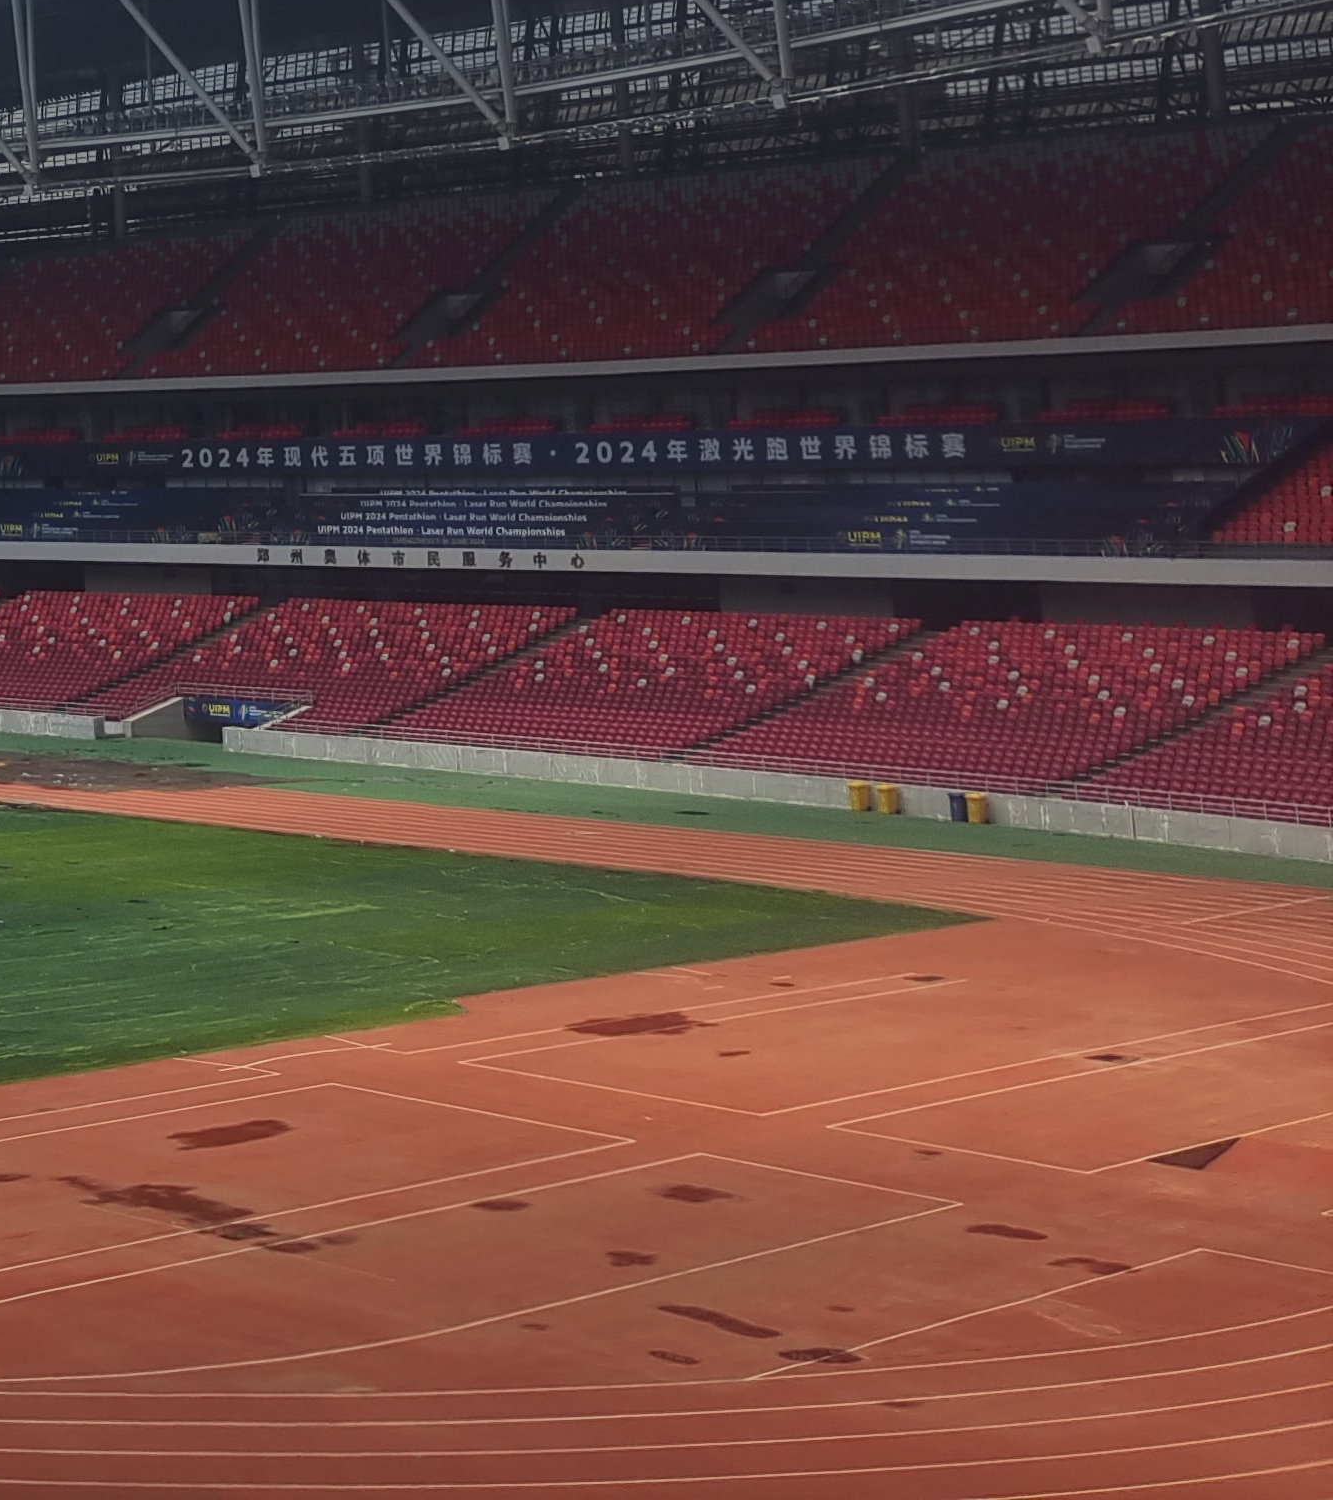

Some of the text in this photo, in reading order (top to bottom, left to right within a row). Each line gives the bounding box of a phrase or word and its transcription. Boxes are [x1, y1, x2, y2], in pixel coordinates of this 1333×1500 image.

[317, 525, 340, 534] UIPM
[343, 525, 364, 534] 2024
[421, 526, 444, 535] Laser
[447, 526, 464, 535] Run
[466, 526, 493, 536] World
